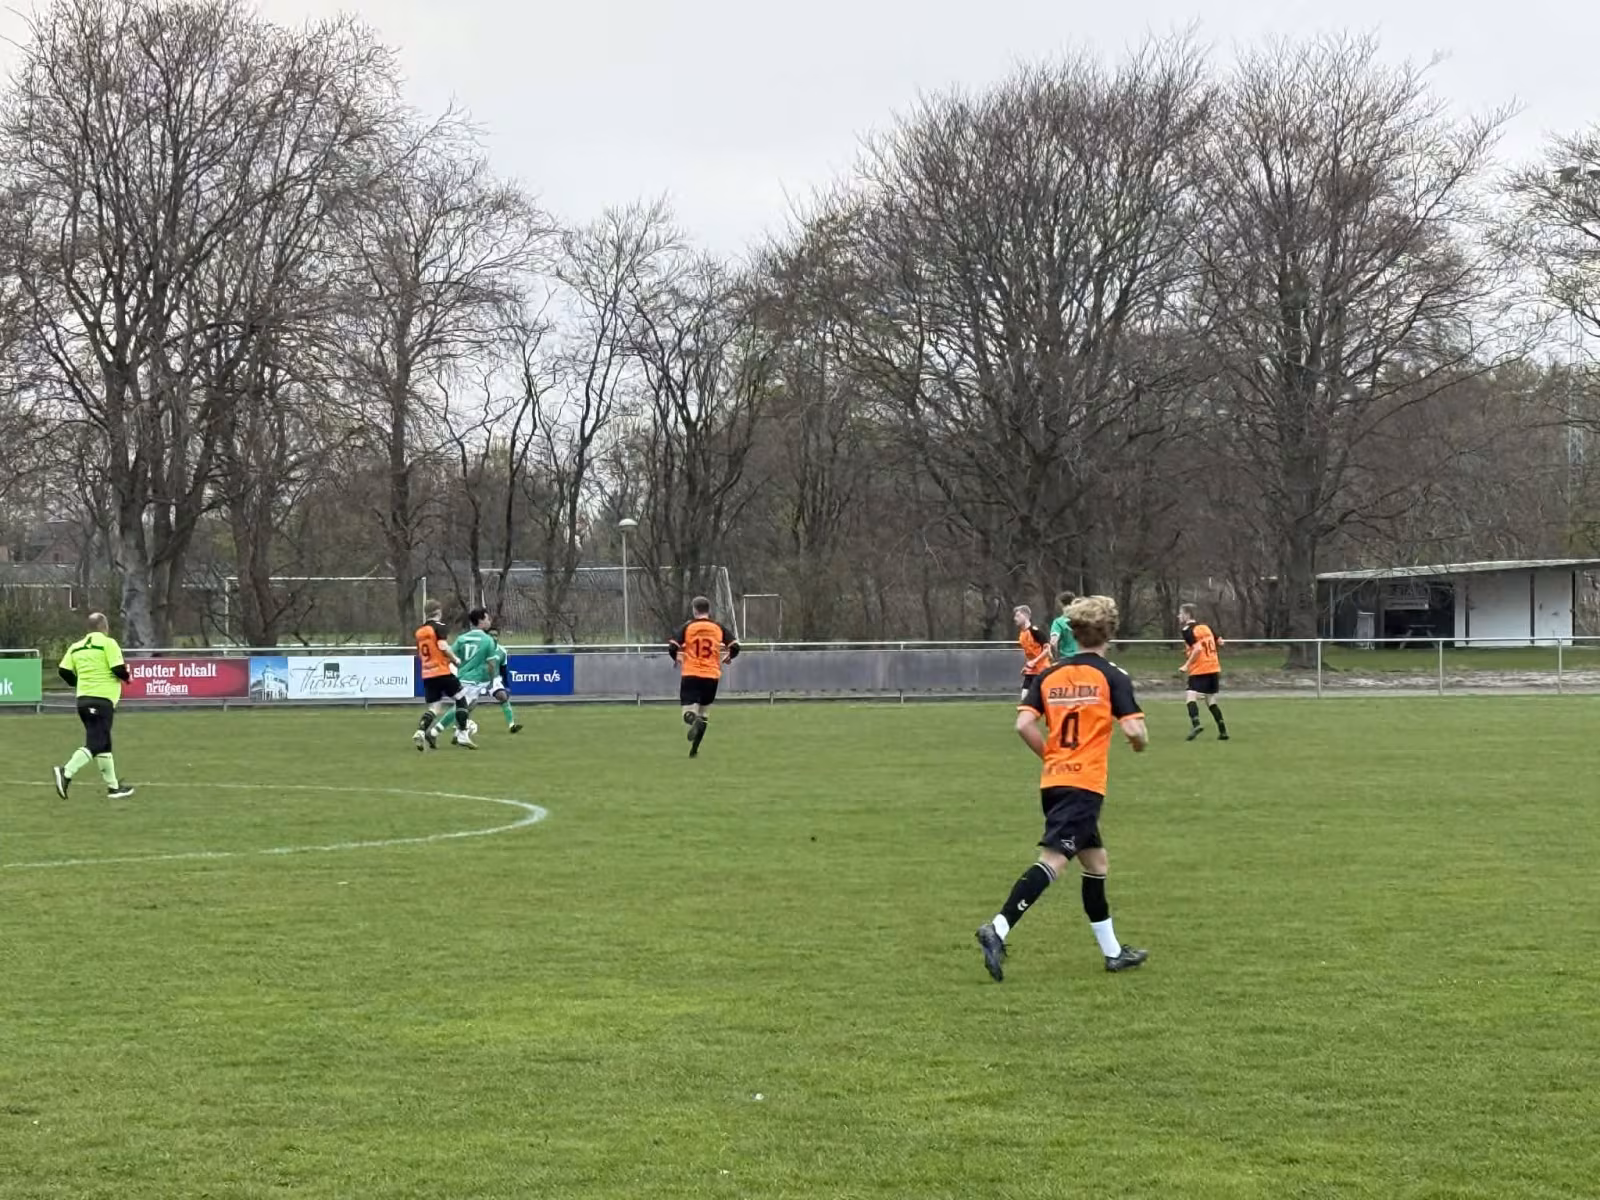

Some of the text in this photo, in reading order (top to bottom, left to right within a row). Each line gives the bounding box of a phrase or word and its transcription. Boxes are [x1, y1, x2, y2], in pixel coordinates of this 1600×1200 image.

[422, 643, 431, 663] 9
[464, 643, 478, 661] 17
[693, 638, 713, 659] 13
[510, 671, 540, 682] Tarm
